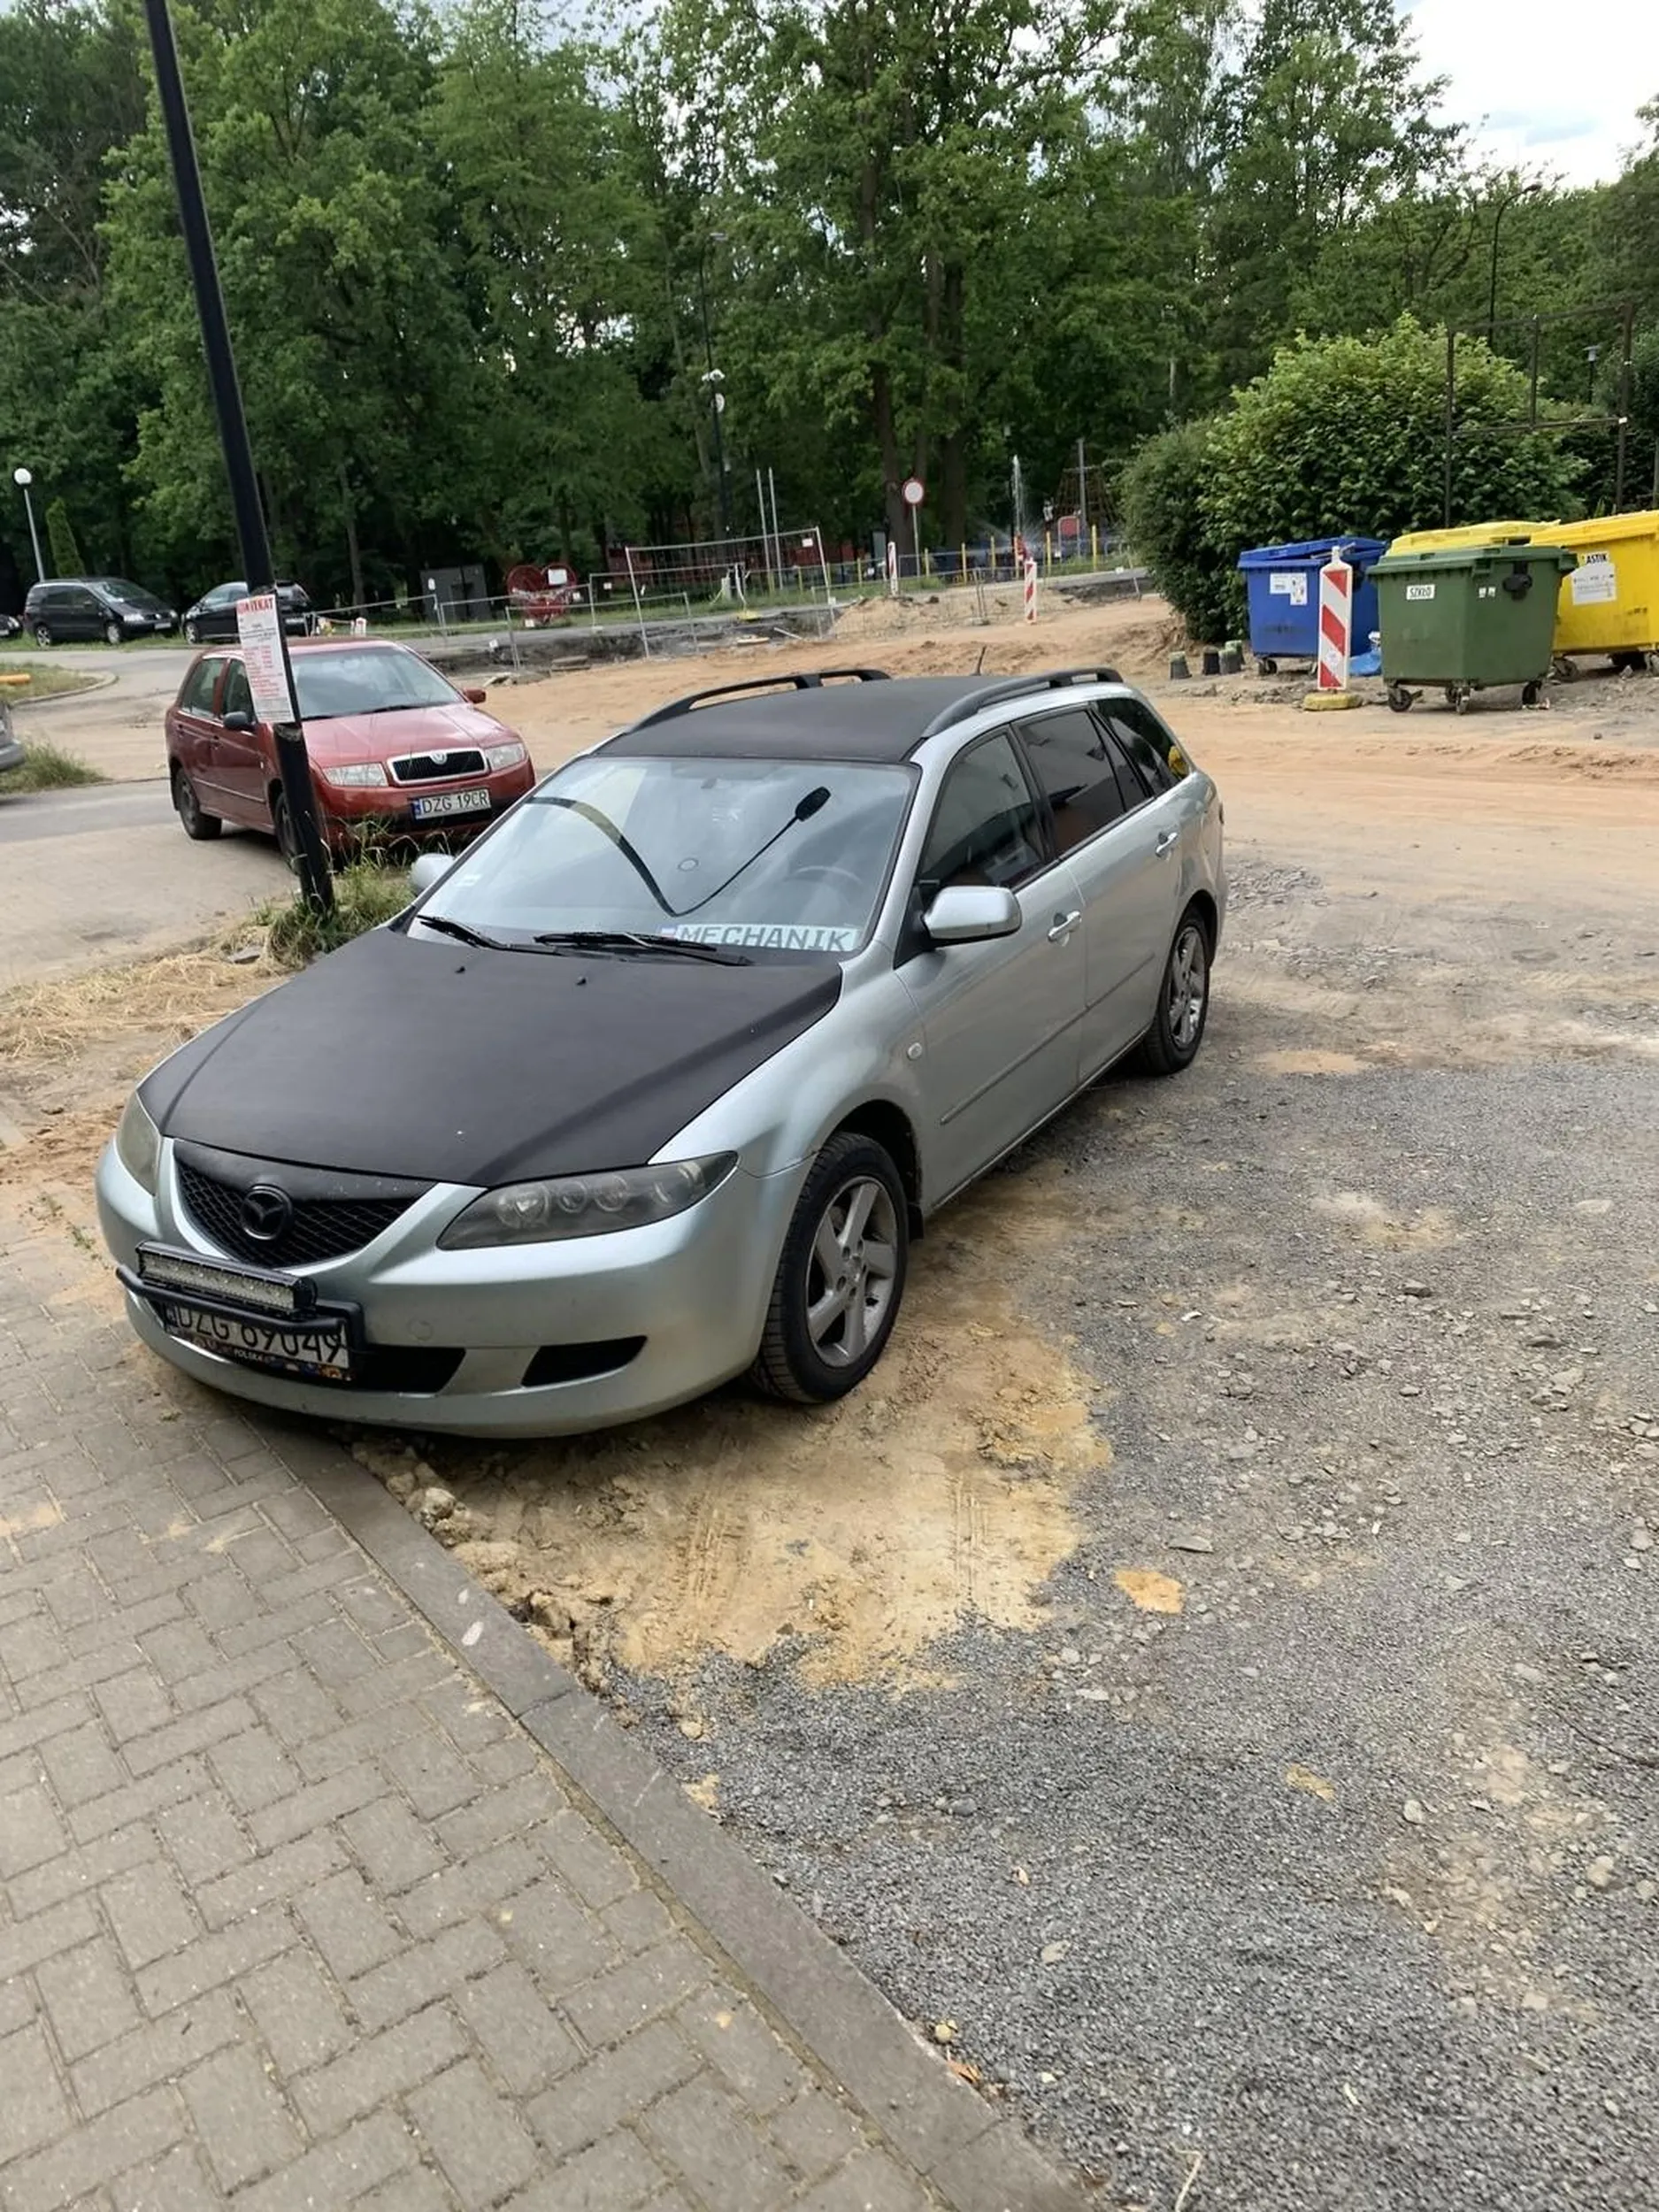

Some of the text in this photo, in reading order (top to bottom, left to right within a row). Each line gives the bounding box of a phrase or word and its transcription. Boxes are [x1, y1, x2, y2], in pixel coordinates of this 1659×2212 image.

[422, 790, 488, 814] DZG 19CR
[679, 926, 853, 952] MECHANIK
[177, 1307, 230, 1340] DZG
